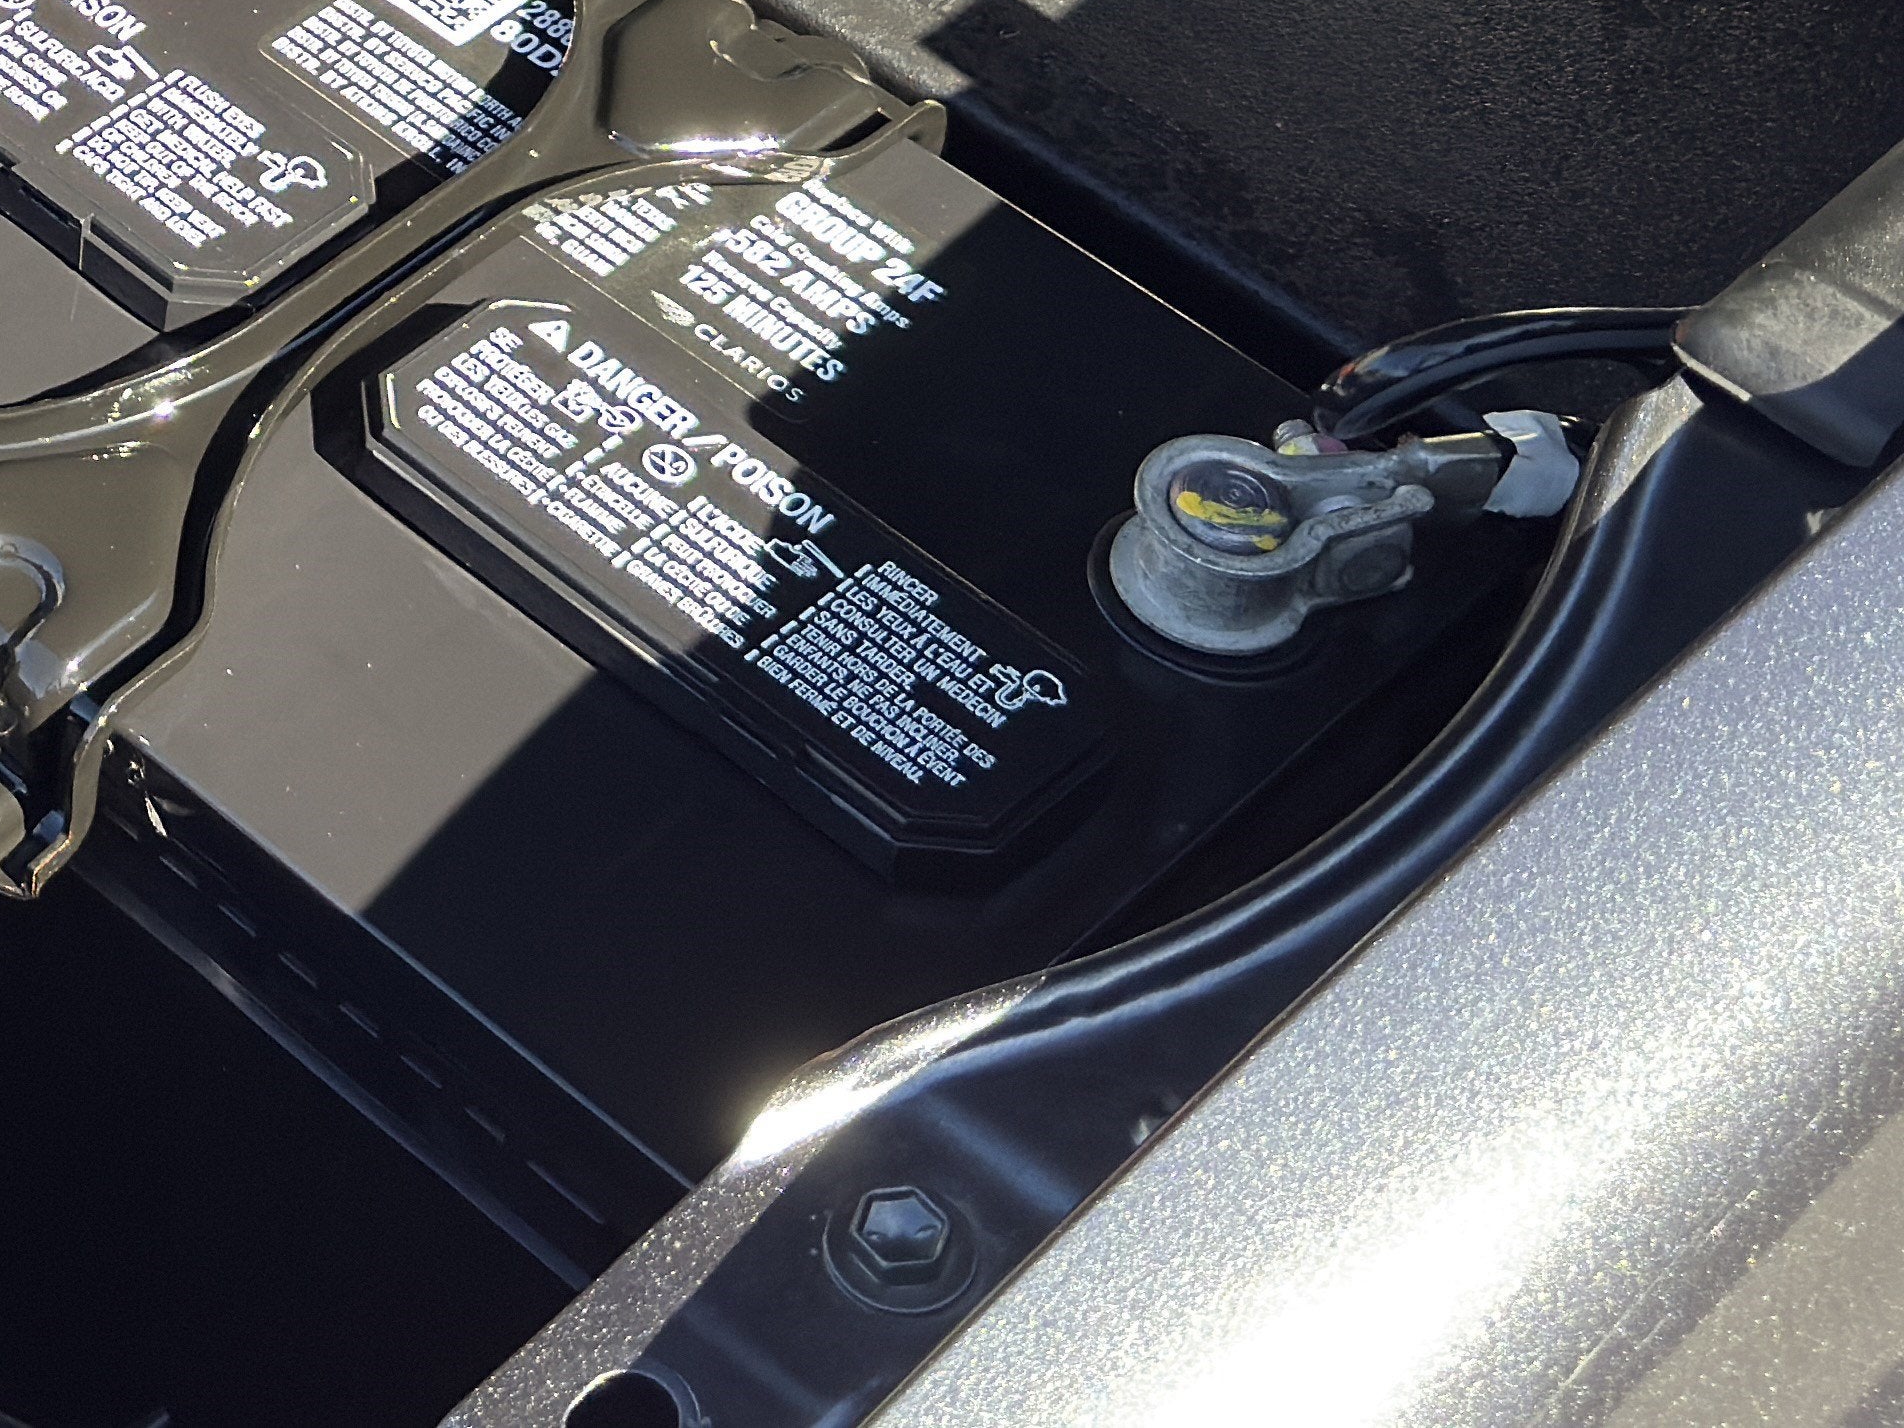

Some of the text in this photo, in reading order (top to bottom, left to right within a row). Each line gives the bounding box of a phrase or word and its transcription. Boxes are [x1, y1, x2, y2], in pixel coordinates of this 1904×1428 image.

[492, 19, 562, 76] 80D
[775, 192, 944, 301] GROUP 24F
[679, 264, 843, 380] 125 MINUTES
[780, 270, 875, 333] AMPS
[858, 290, 910, 328] Amps
[694, 324, 803, 401] CLARIOS
[861, 573, 987, 662] IMMÉDIATEMENT
[877, 561, 938, 606] RINCER
[814, 610, 915, 691] SANS TARDER.
[830, 599, 1007, 728] CONSULTER UN MEDECIN
[845, 586, 878, 610] LES
[876, 606, 917, 639] YEUX
[923, 643, 973, 678] L'EAU
[967, 673, 995, 693] ET
[757, 656, 923, 784] BIEN FERMÉ ET DE NIVEAU.
[773, 645, 828, 686] GARDER
[824, 683, 847, 700] LE
[842, 696, 910, 748] BOUCHON
[917, 751, 966, 786] ÉVENT
[785, 634, 959, 765] ENFANTS. NE PAS INCLINER.
[801, 623, 995, 768] TENIR HORS DE LA PORTÉE DES
